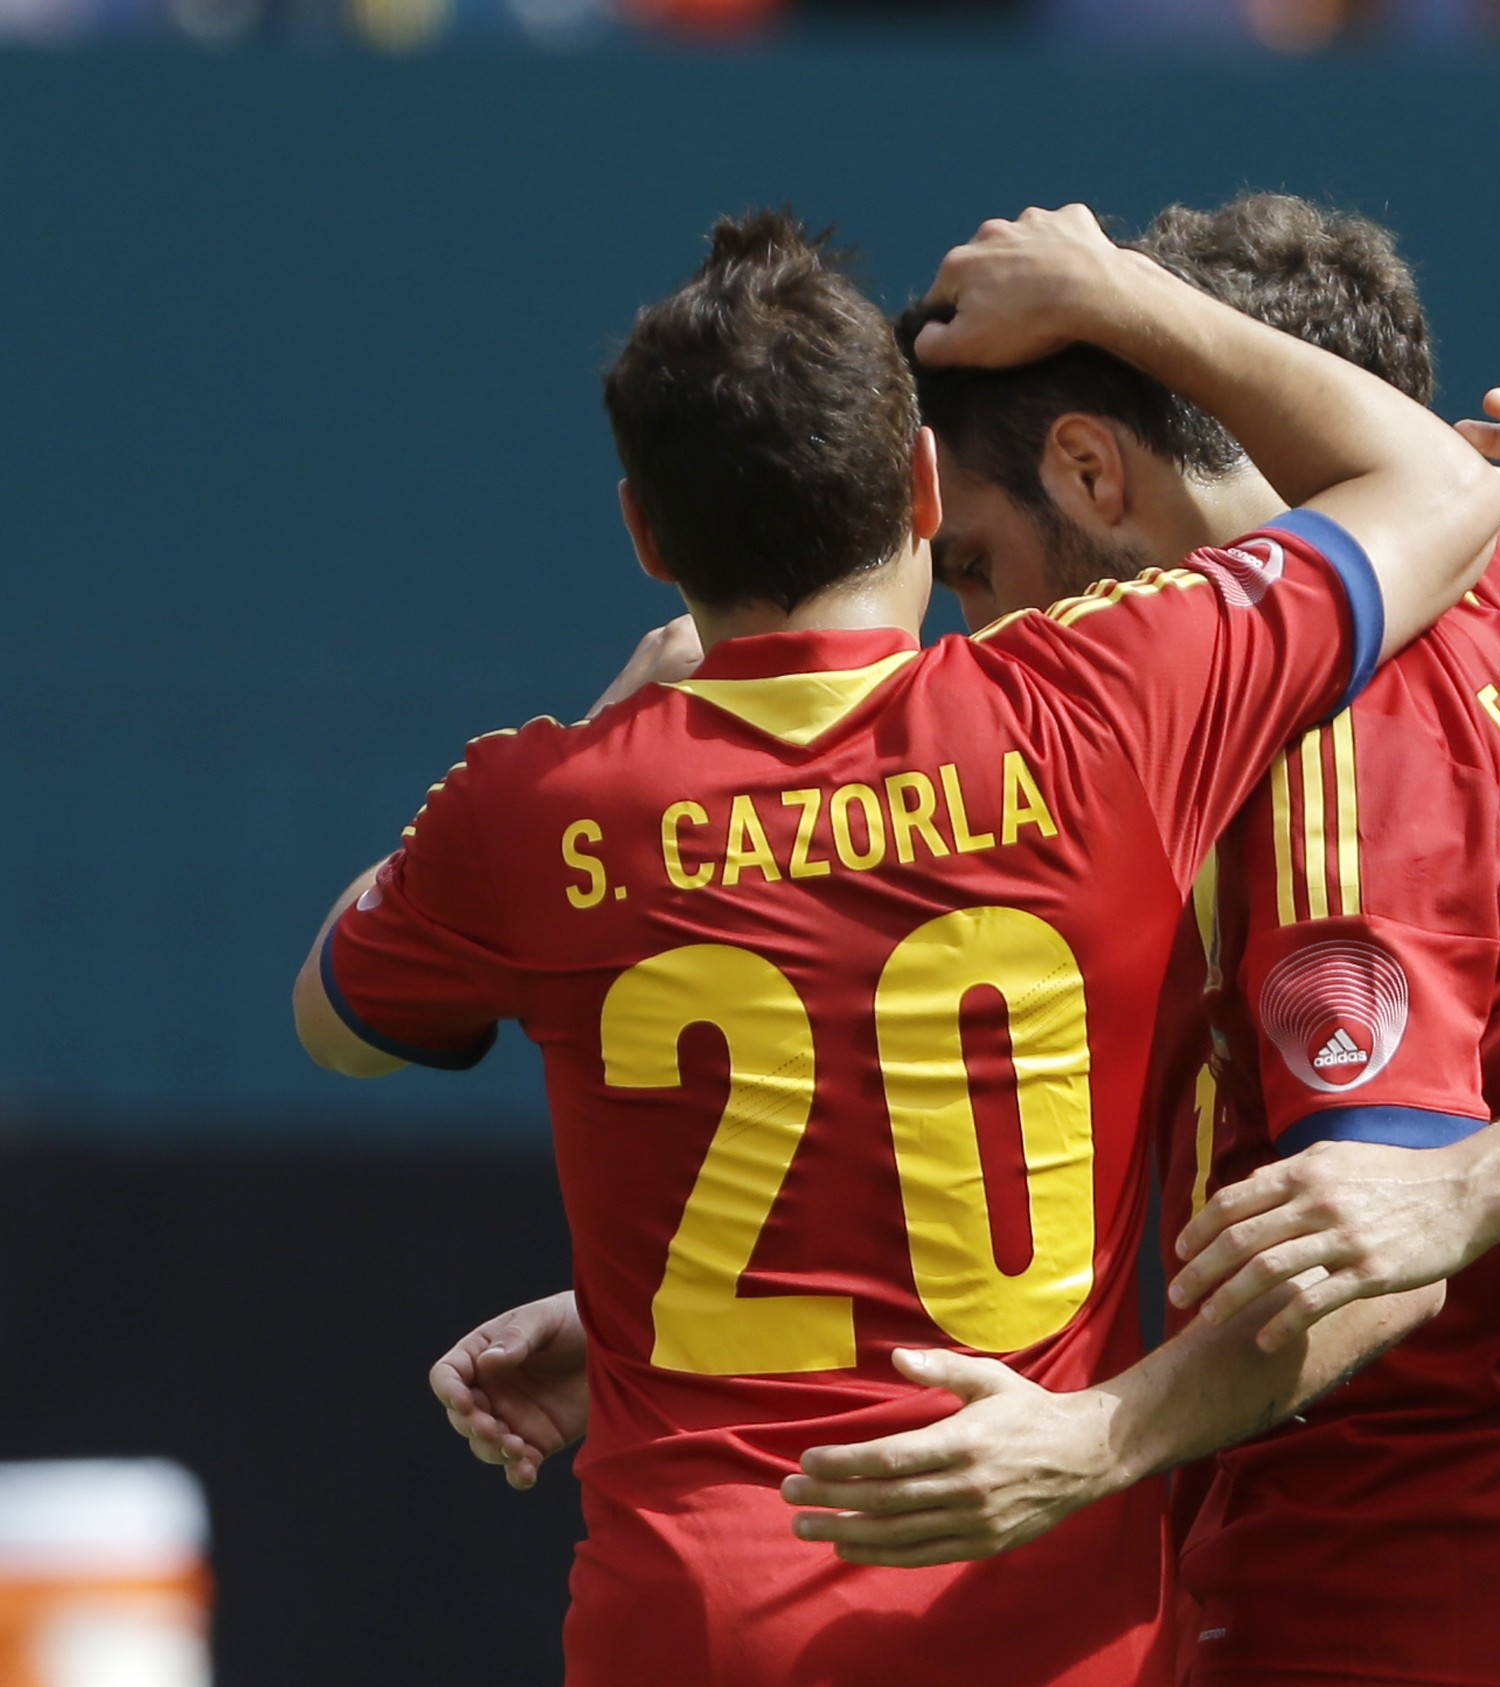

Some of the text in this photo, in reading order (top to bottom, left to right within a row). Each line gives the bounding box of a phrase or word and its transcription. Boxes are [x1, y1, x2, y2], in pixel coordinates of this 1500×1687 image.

[561, 750, 1059, 910] S. CAZORLA
[1313, 1050, 1368, 1068] adidas
[600, 905, 1095, 1376] 20
